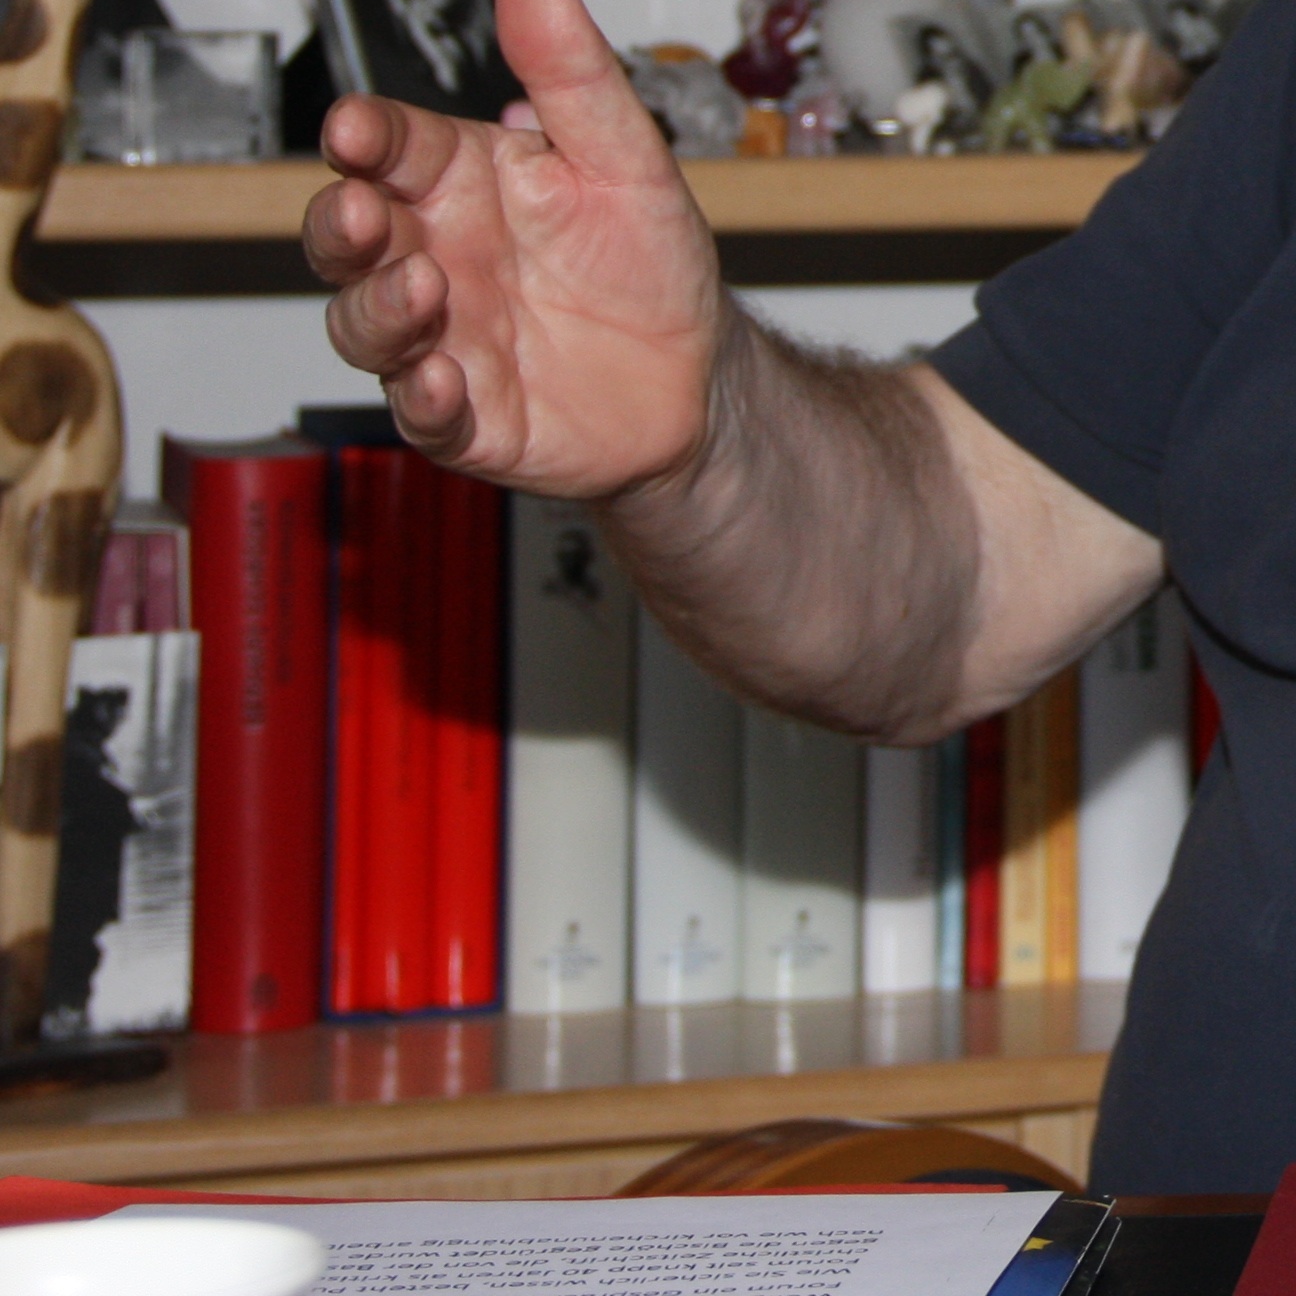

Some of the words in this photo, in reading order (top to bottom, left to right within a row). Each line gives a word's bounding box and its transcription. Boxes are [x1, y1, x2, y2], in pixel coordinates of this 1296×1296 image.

[819, 1230, 883, 1239] nach
[421, 1234, 695, 1247] kirchenunabhängig
[792, 1238, 878, 1247] gegen
[449, 1246, 601, 1257] gegründet
[610, 1243, 728, 1251] Bischöfe
[347, 1252, 439, 1260] wurde
[722, 1248, 868, 1258] christliche
[562, 1253, 713, 1264] Zeitschrift,
[768, 1259, 860, 1267] Forum
[384, 1263, 434, 1271] der
[608, 1264, 696, 1273] knapp
[457, 1270, 555, 1278] Jahren
[745, 1270, 787, 1278] Sie
[796, 1268, 850, 1277] Wie
[598, 1273, 735, 1285] sicherlich
[356, 1283, 469, 1293] besteht
[748, 1282, 842, 1291] Forum
